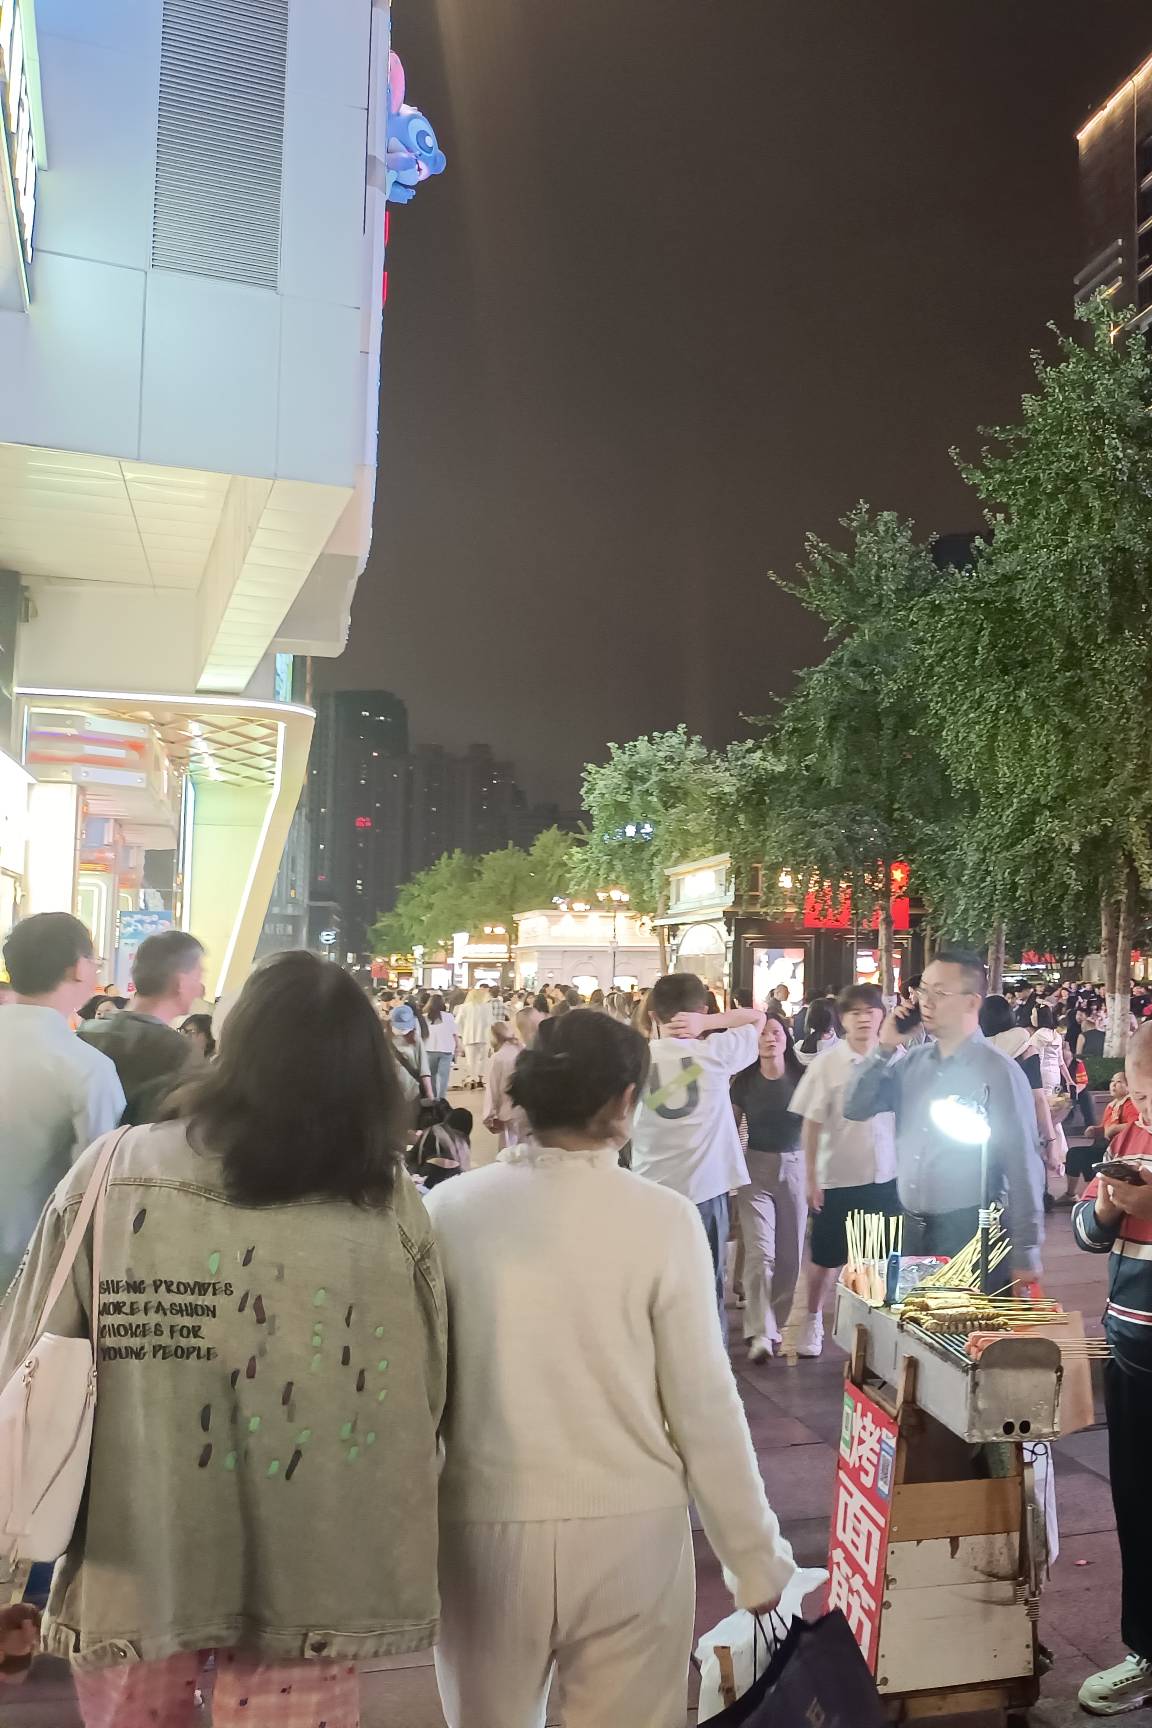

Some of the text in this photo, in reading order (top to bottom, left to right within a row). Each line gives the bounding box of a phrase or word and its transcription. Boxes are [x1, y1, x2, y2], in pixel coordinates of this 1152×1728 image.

[152, 1279, 234, 1296] PROVIDES
[144, 1301, 217, 1318] FASHION
[99, 1323, 205, 1340] CHOICES FOR
[152, 1344, 218, 1360] PEOPLE
[828, 1402, 887, 1661] 烤面筋
